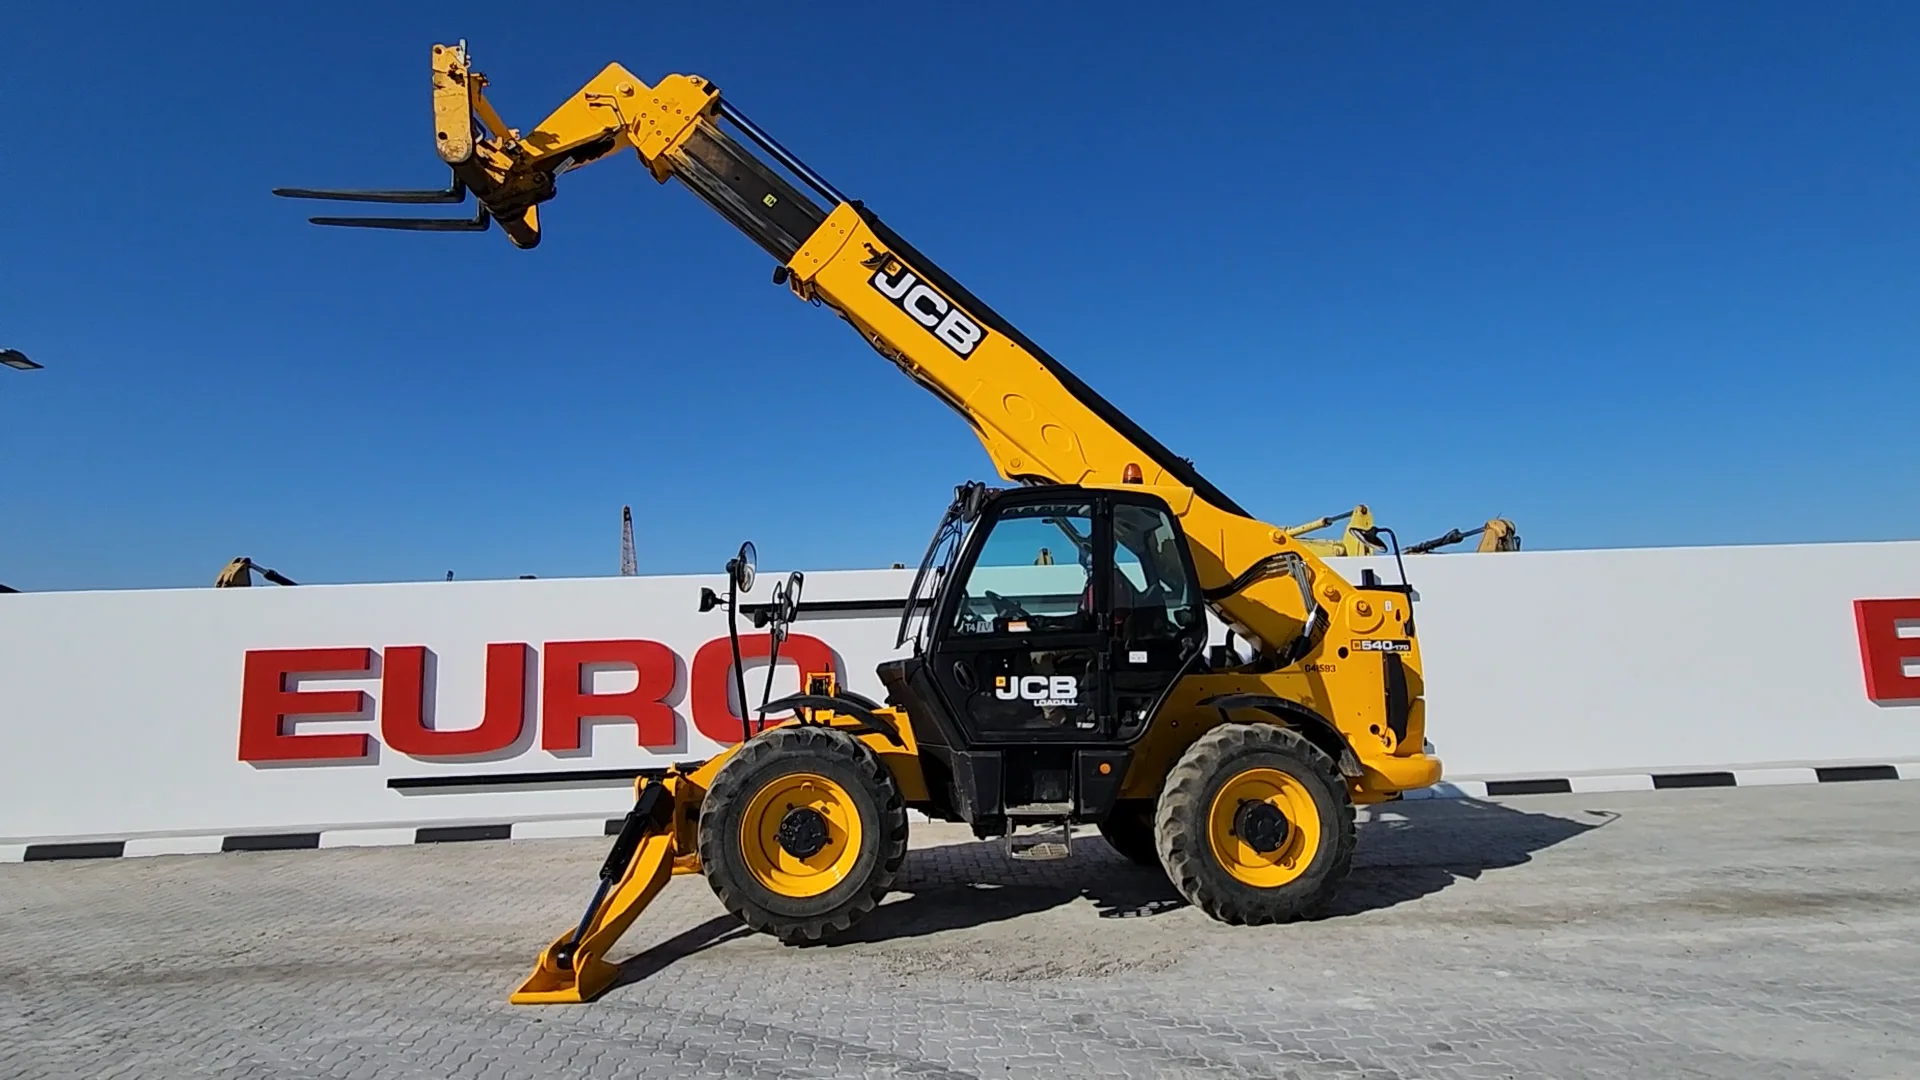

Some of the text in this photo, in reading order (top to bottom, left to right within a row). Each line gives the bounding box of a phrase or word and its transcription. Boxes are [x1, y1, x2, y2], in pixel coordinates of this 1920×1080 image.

[875, 271, 981, 354] JCB
[238, 633, 838, 768] EURO
[995, 676, 1078, 700] JCB
